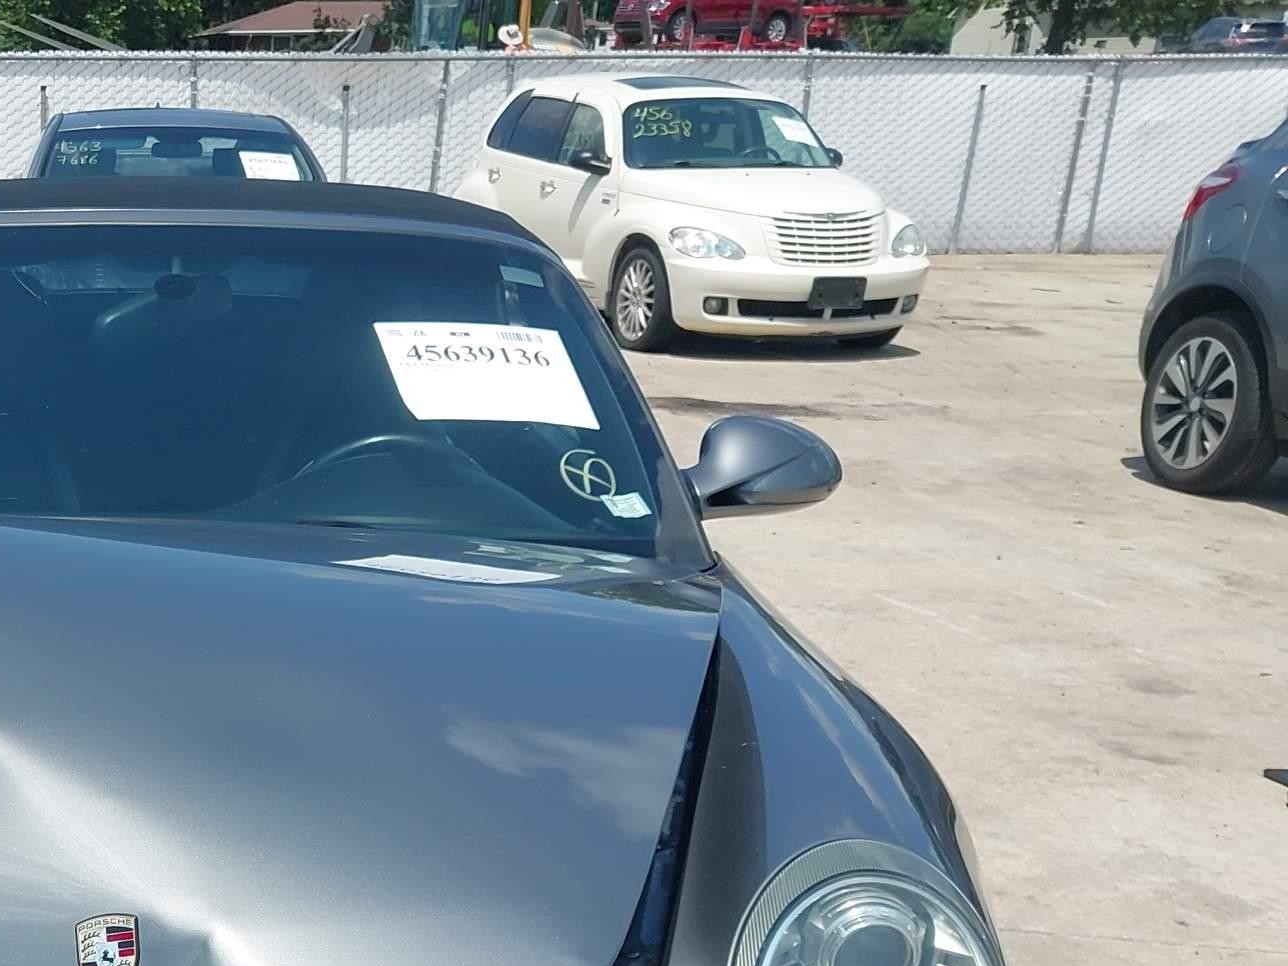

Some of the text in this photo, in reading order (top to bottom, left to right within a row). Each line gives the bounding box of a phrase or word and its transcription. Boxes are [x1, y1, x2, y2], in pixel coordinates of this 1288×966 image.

[633, 107, 673, 122] 456
[632, 120, 693, 139] 23358
[56, 153, 99, 165] 7686
[406, 344, 551, 368] 45639136
[78, 917, 134, 932] PORSCHE
